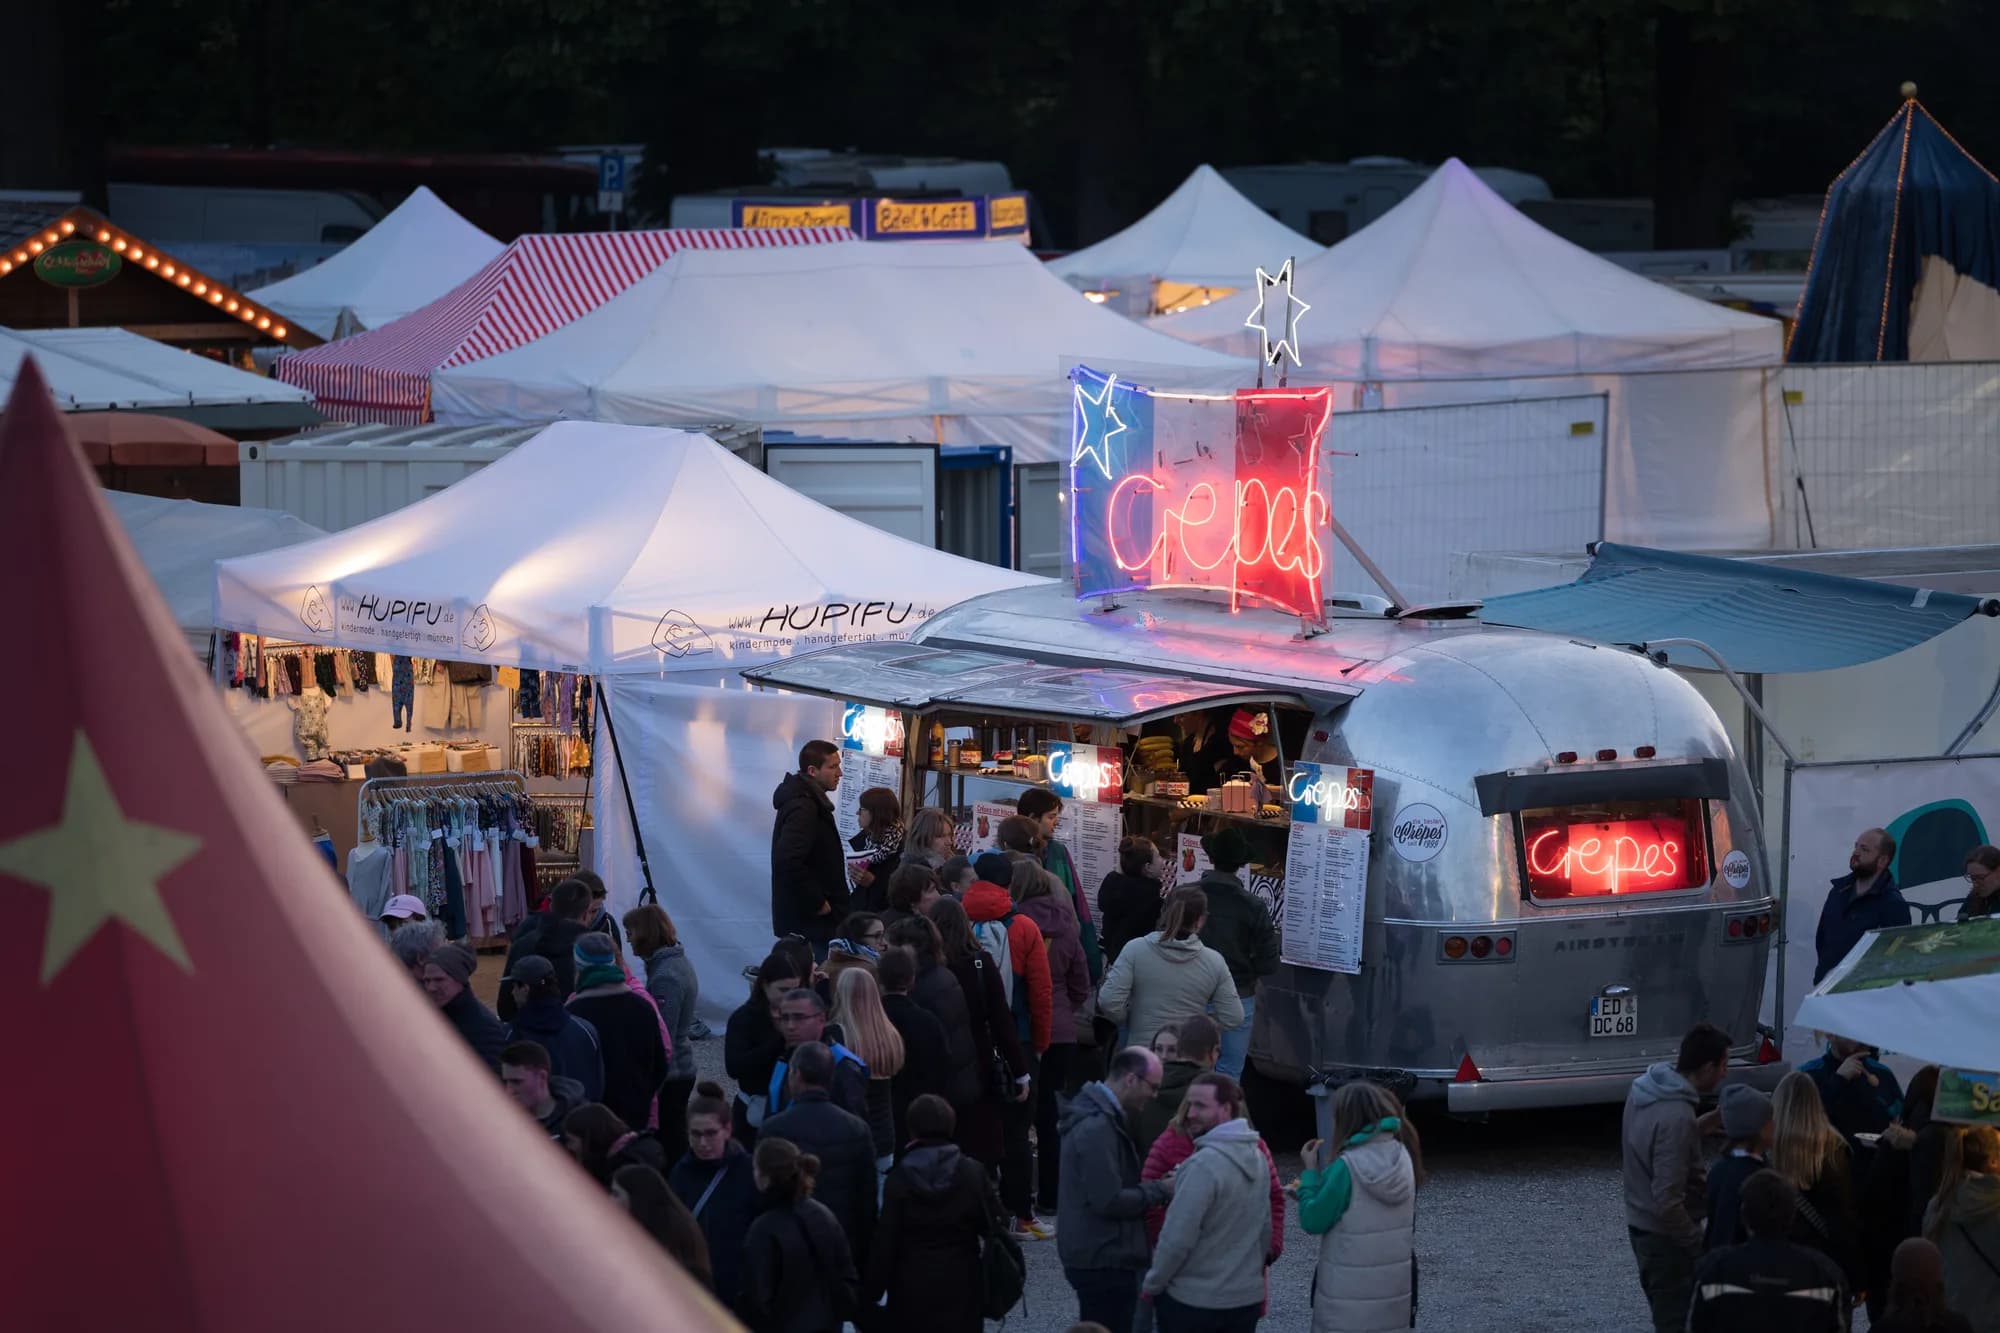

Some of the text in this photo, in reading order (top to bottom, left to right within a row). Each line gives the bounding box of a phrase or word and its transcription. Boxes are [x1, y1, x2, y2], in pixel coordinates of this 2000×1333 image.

[604, 158, 619, 189] P
[1108, 474, 1327, 614] Crepes
[357, 594, 442, 626] HUPIFU
[759, 601, 913, 633] HUPIFU
[341, 623, 376, 636] kindermode
[729, 637, 792, 650] kindermode
[804, 631, 876, 645] handgefertigt
[1531, 829, 1679, 894] Crepes
[1602, 998, 1621, 1015] ED
[1594, 1016, 1634, 1034] DC 68
